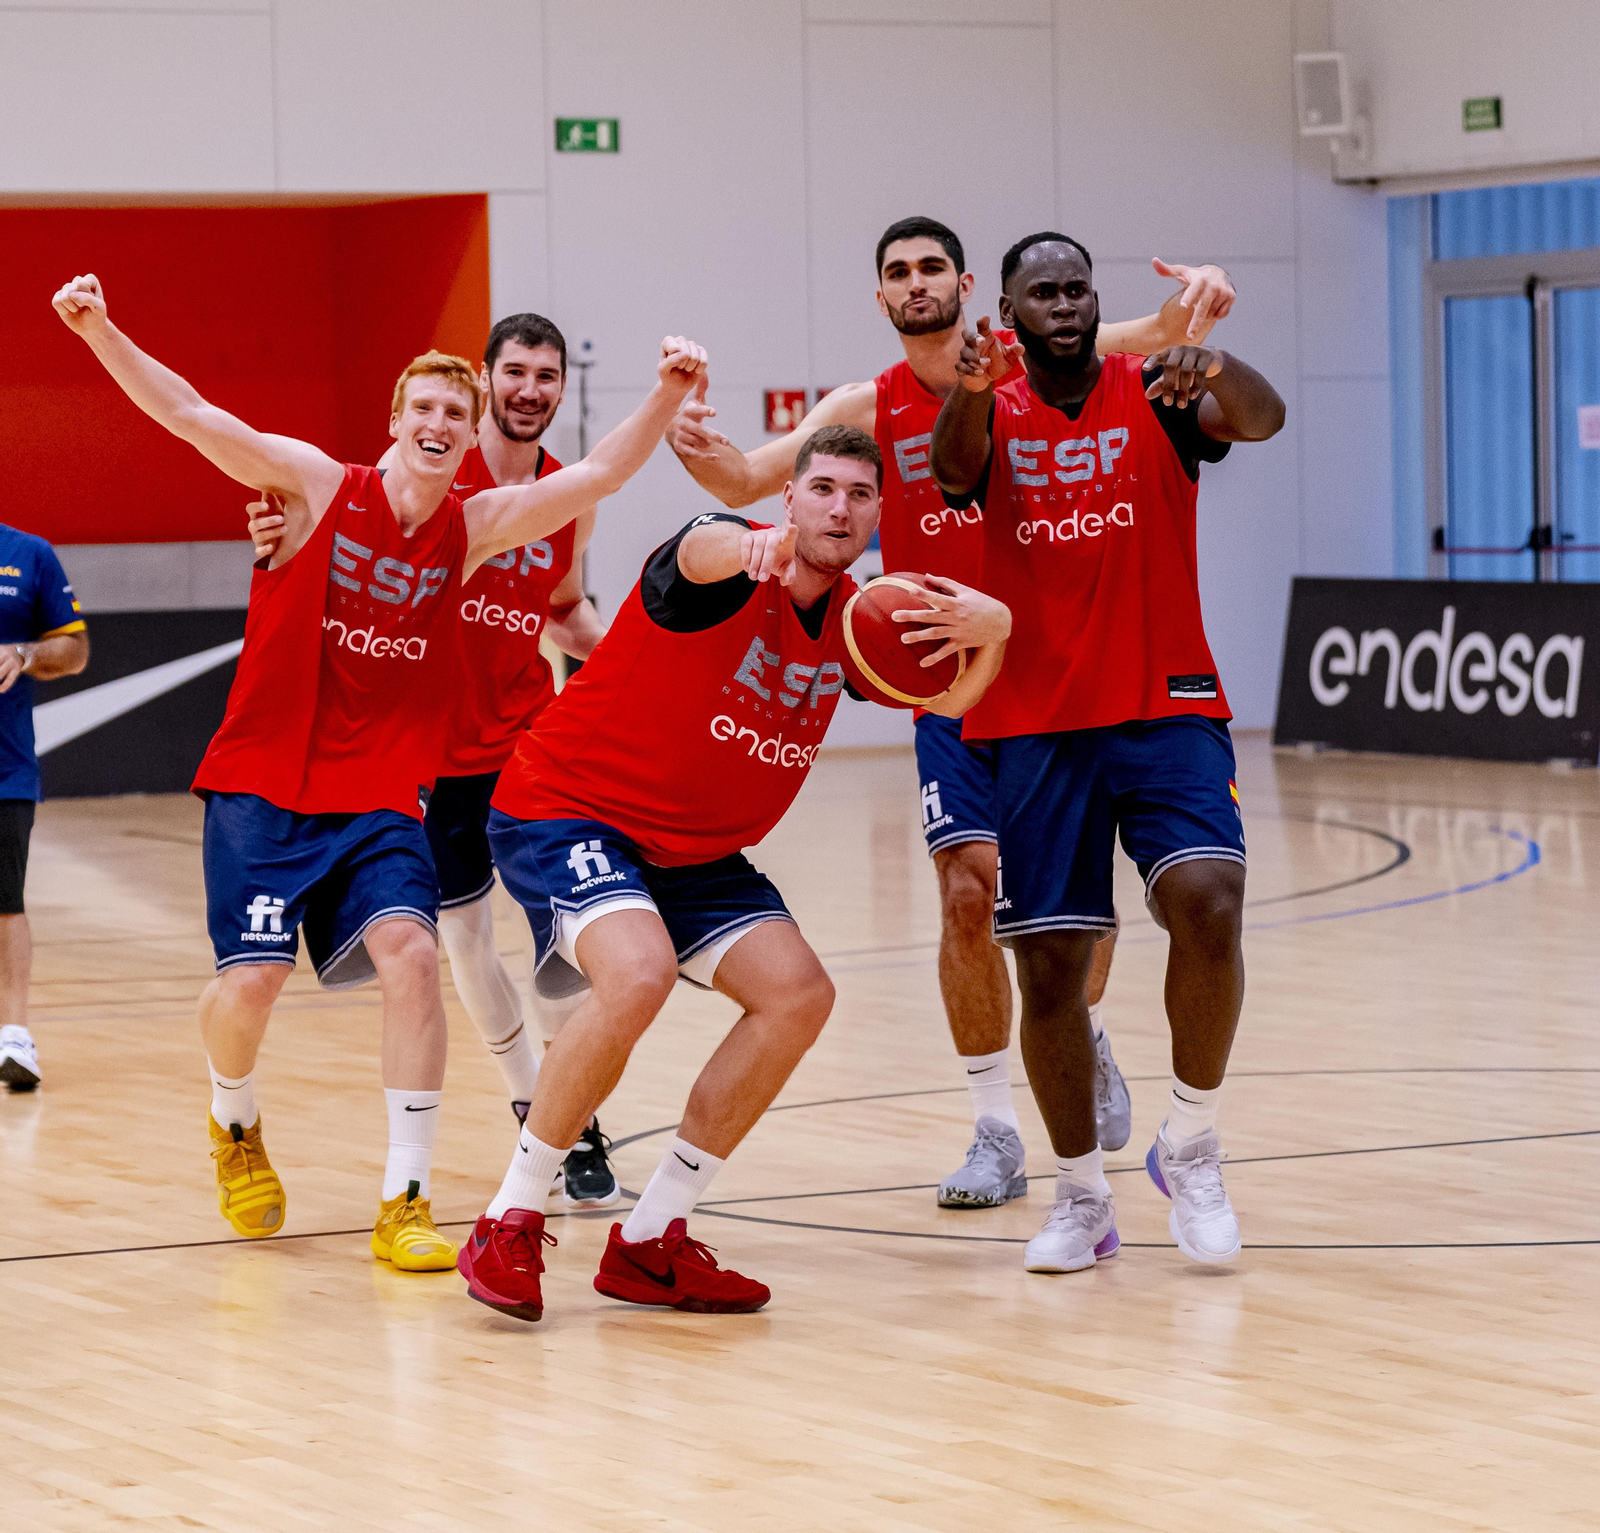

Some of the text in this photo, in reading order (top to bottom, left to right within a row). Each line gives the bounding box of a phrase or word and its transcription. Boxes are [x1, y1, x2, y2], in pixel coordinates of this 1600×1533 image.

[1008, 427, 1129, 487] ESP
[920, 499, 984, 536] end
[1016, 502, 1134, 545] endea
[330, 531, 448, 609] ESP
[460, 594, 541, 636] desa
[321, 616, 428, 661] ndesa
[733, 635, 845, 709] ESP
[1309, 605, 1585, 718] endesa
[571, 870, 627, 894] network
[241, 932, 292, 942] network
